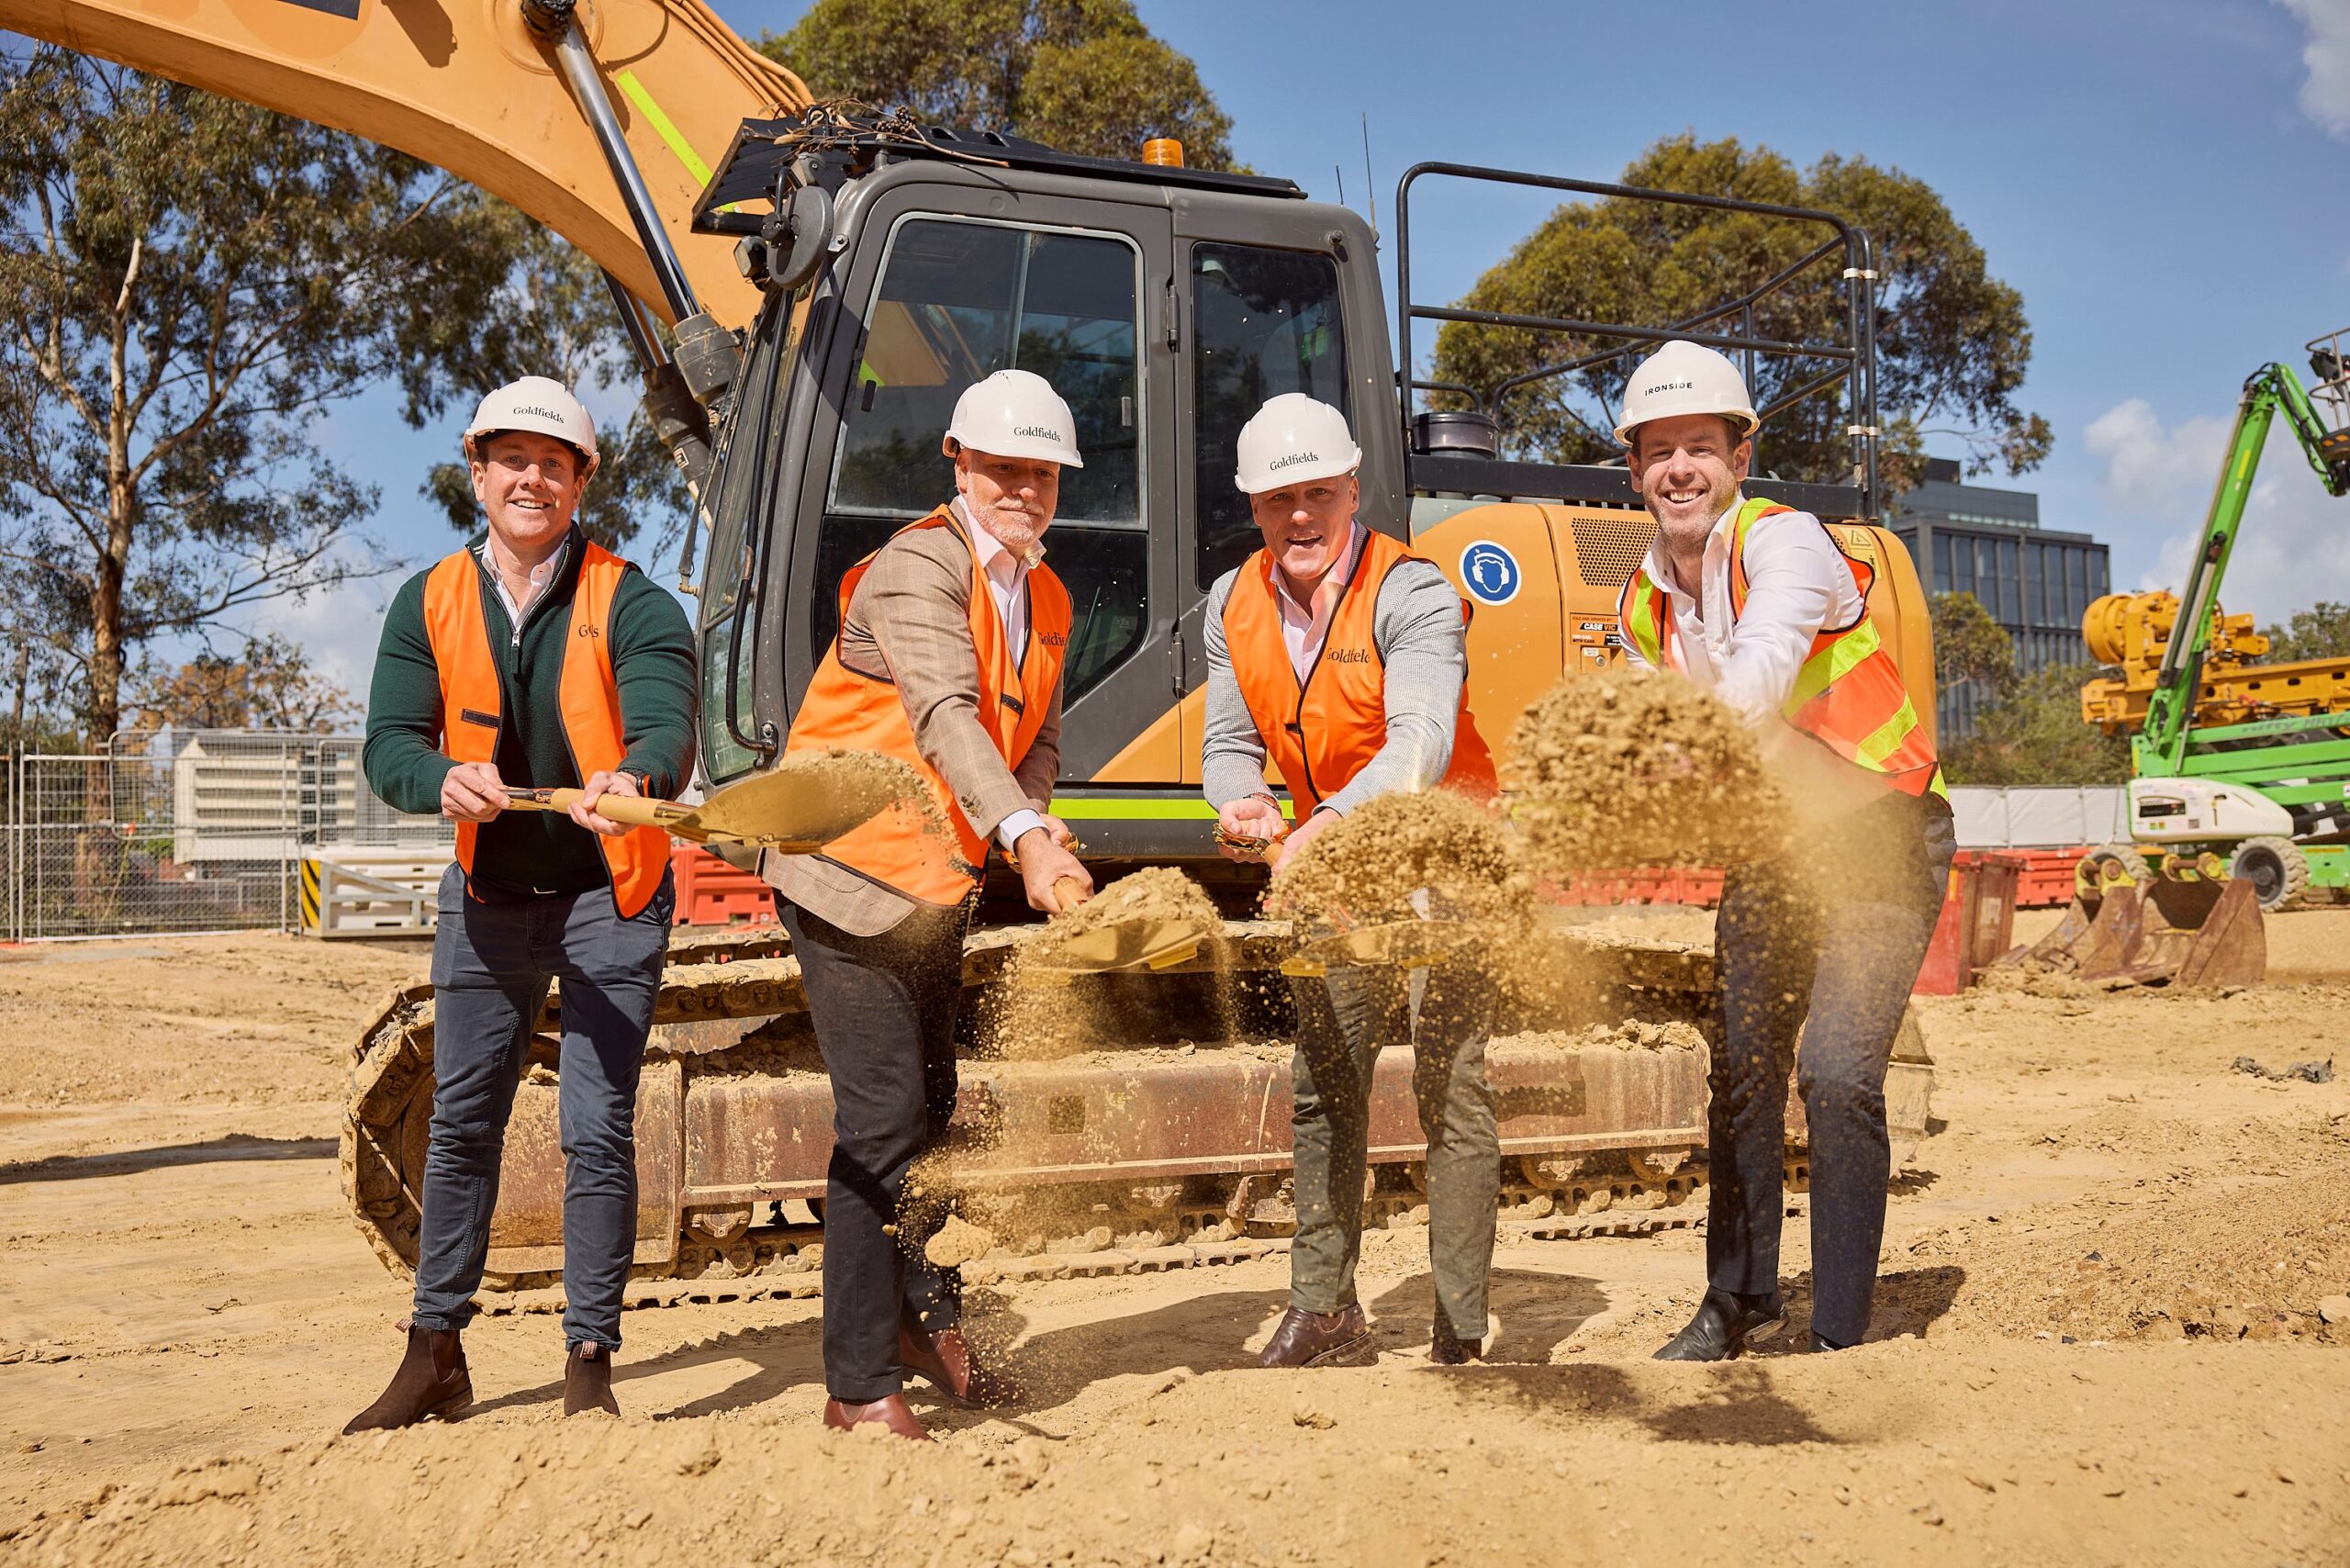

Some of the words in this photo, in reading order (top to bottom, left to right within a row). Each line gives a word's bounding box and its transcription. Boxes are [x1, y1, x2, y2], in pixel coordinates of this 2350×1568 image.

[1645, 382, 1693, 397] IRONSIDE
[513, 406, 565, 423] Goldfields
[1013, 426, 1061, 442] Goldfields
[1270, 452, 1319, 471] Goldfields
